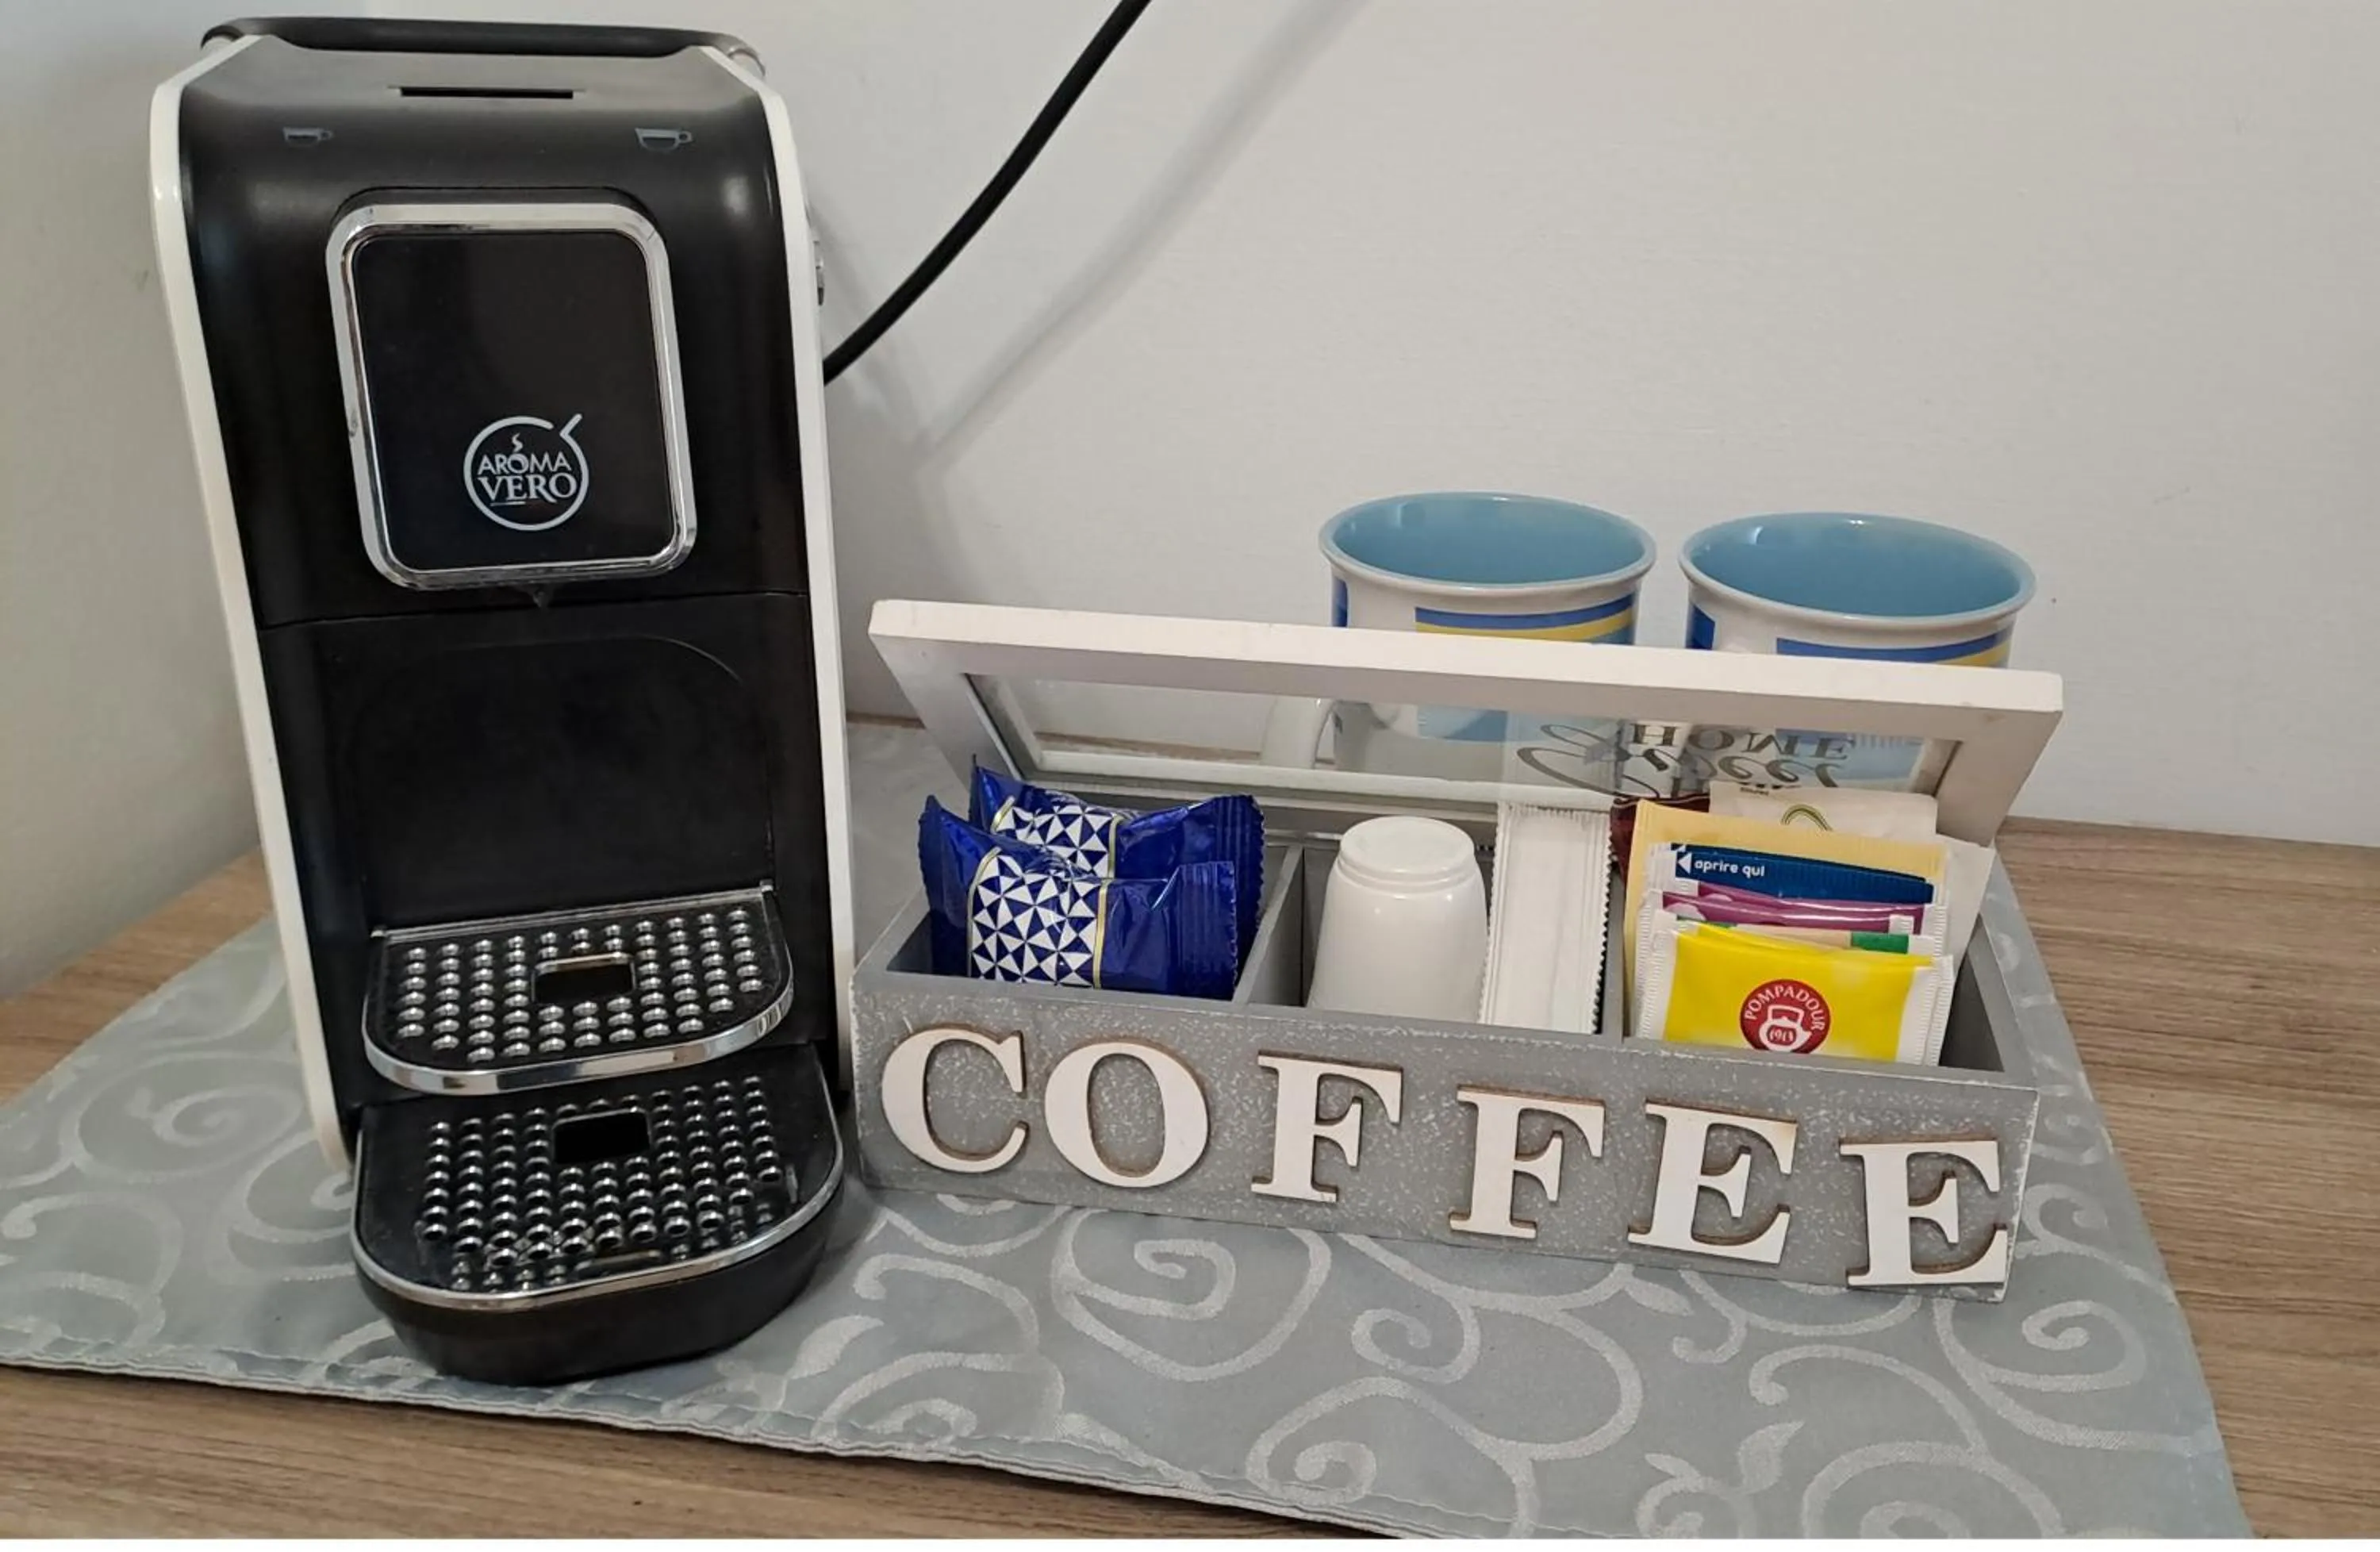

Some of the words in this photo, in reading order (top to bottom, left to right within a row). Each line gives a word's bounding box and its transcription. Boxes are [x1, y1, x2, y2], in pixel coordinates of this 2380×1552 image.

[478, 451, 572, 475] AROMA
[477, 473, 577, 504] VERO
[1694, 859, 1738, 874] aprire
[1741, 865, 1765, 878] qui
[1744, 985, 1825, 1031] POMPADOUR
[881, 1024, 2008, 1287] COFFEE
